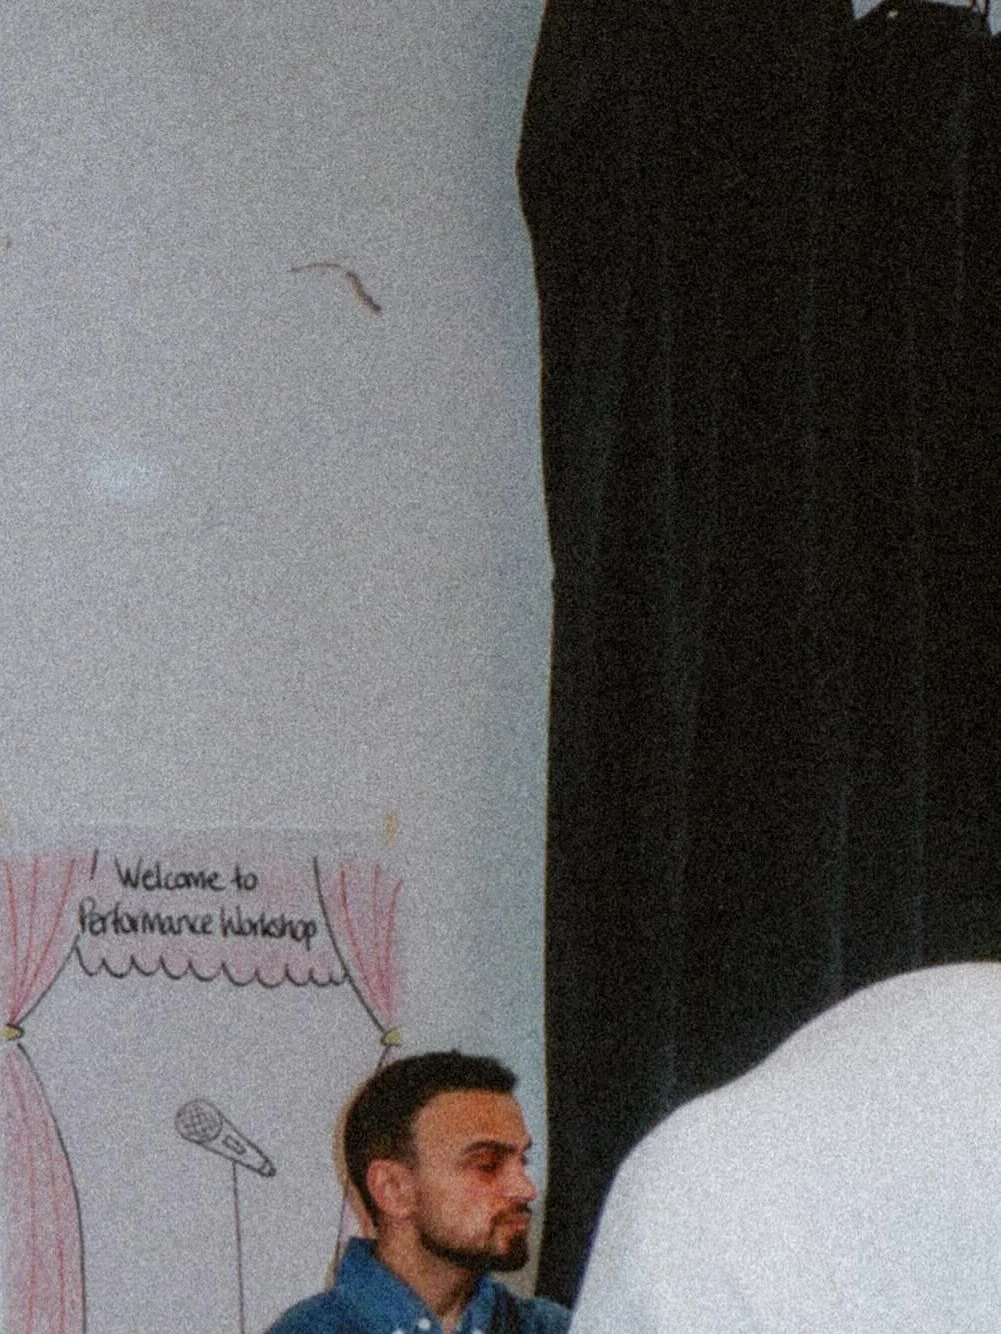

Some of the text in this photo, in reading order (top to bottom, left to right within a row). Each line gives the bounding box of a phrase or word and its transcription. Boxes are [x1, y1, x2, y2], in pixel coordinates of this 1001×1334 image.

[114, 856, 259, 891] Welcome to
[79, 896, 318, 951] Performance Workshop
